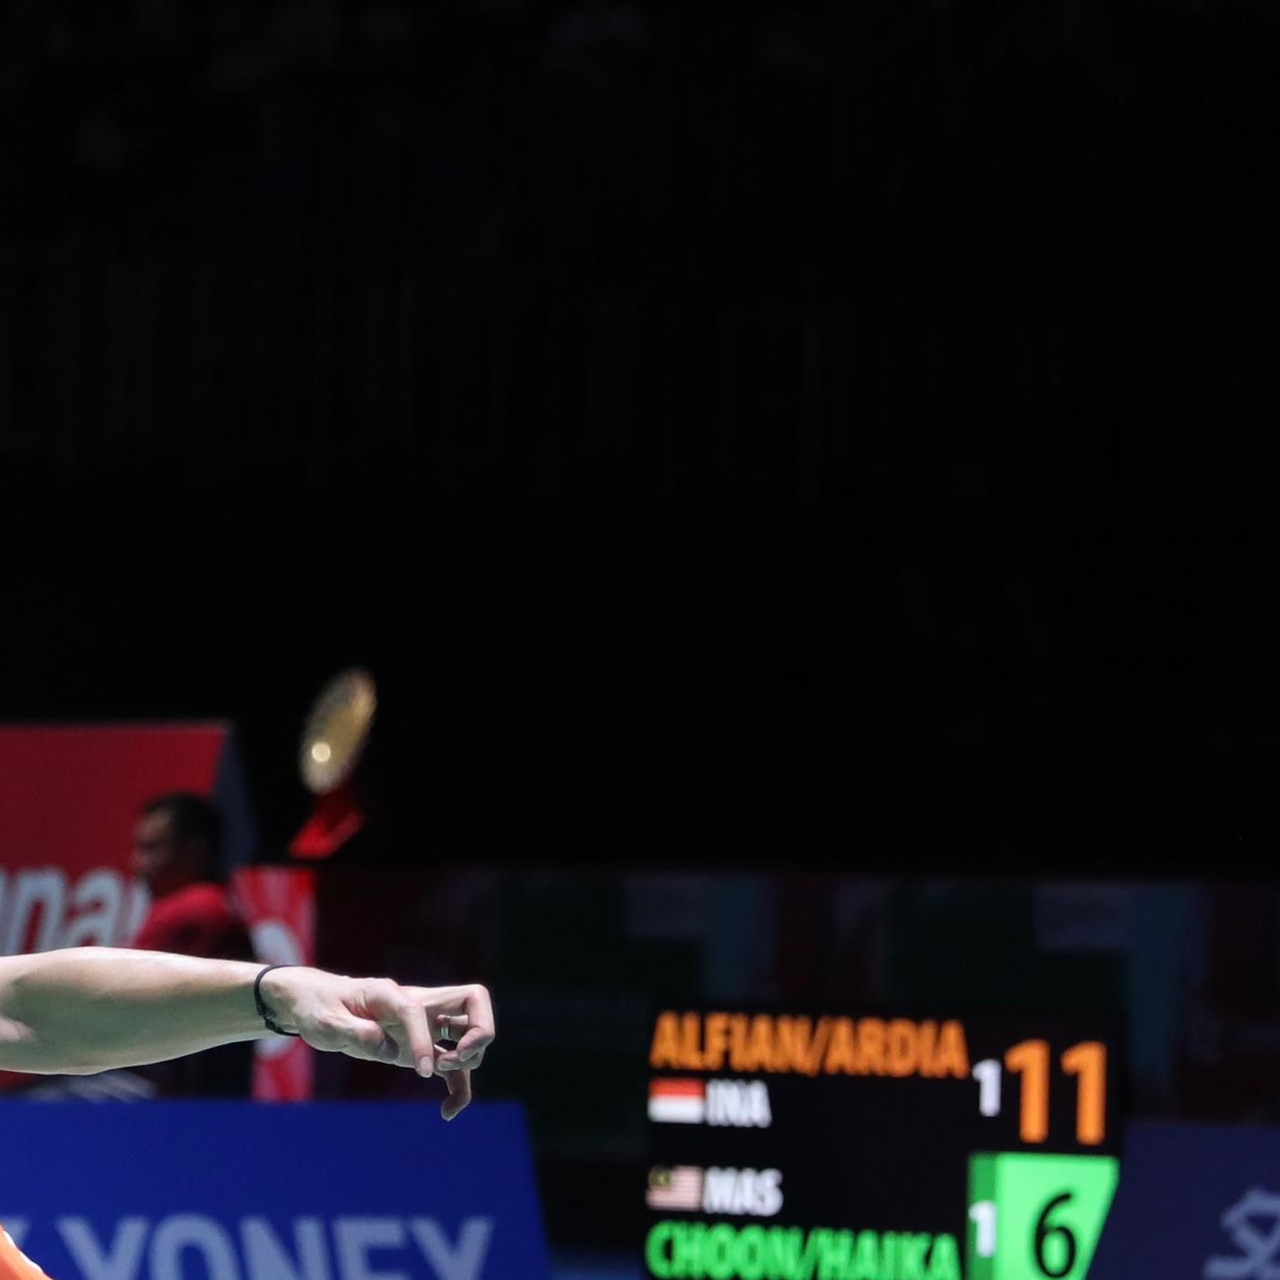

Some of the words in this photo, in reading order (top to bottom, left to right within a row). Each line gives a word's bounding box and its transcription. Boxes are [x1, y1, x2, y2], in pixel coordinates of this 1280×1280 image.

[649, 1011, 970, 1079] ALFIAN/ARDIA
[973, 1059, 1002, 1117] 1
[1004, 1040, 1107, 1145] 11
[969, 1201, 997, 1258] 1
[1034, 1193, 1077, 1280] 6
